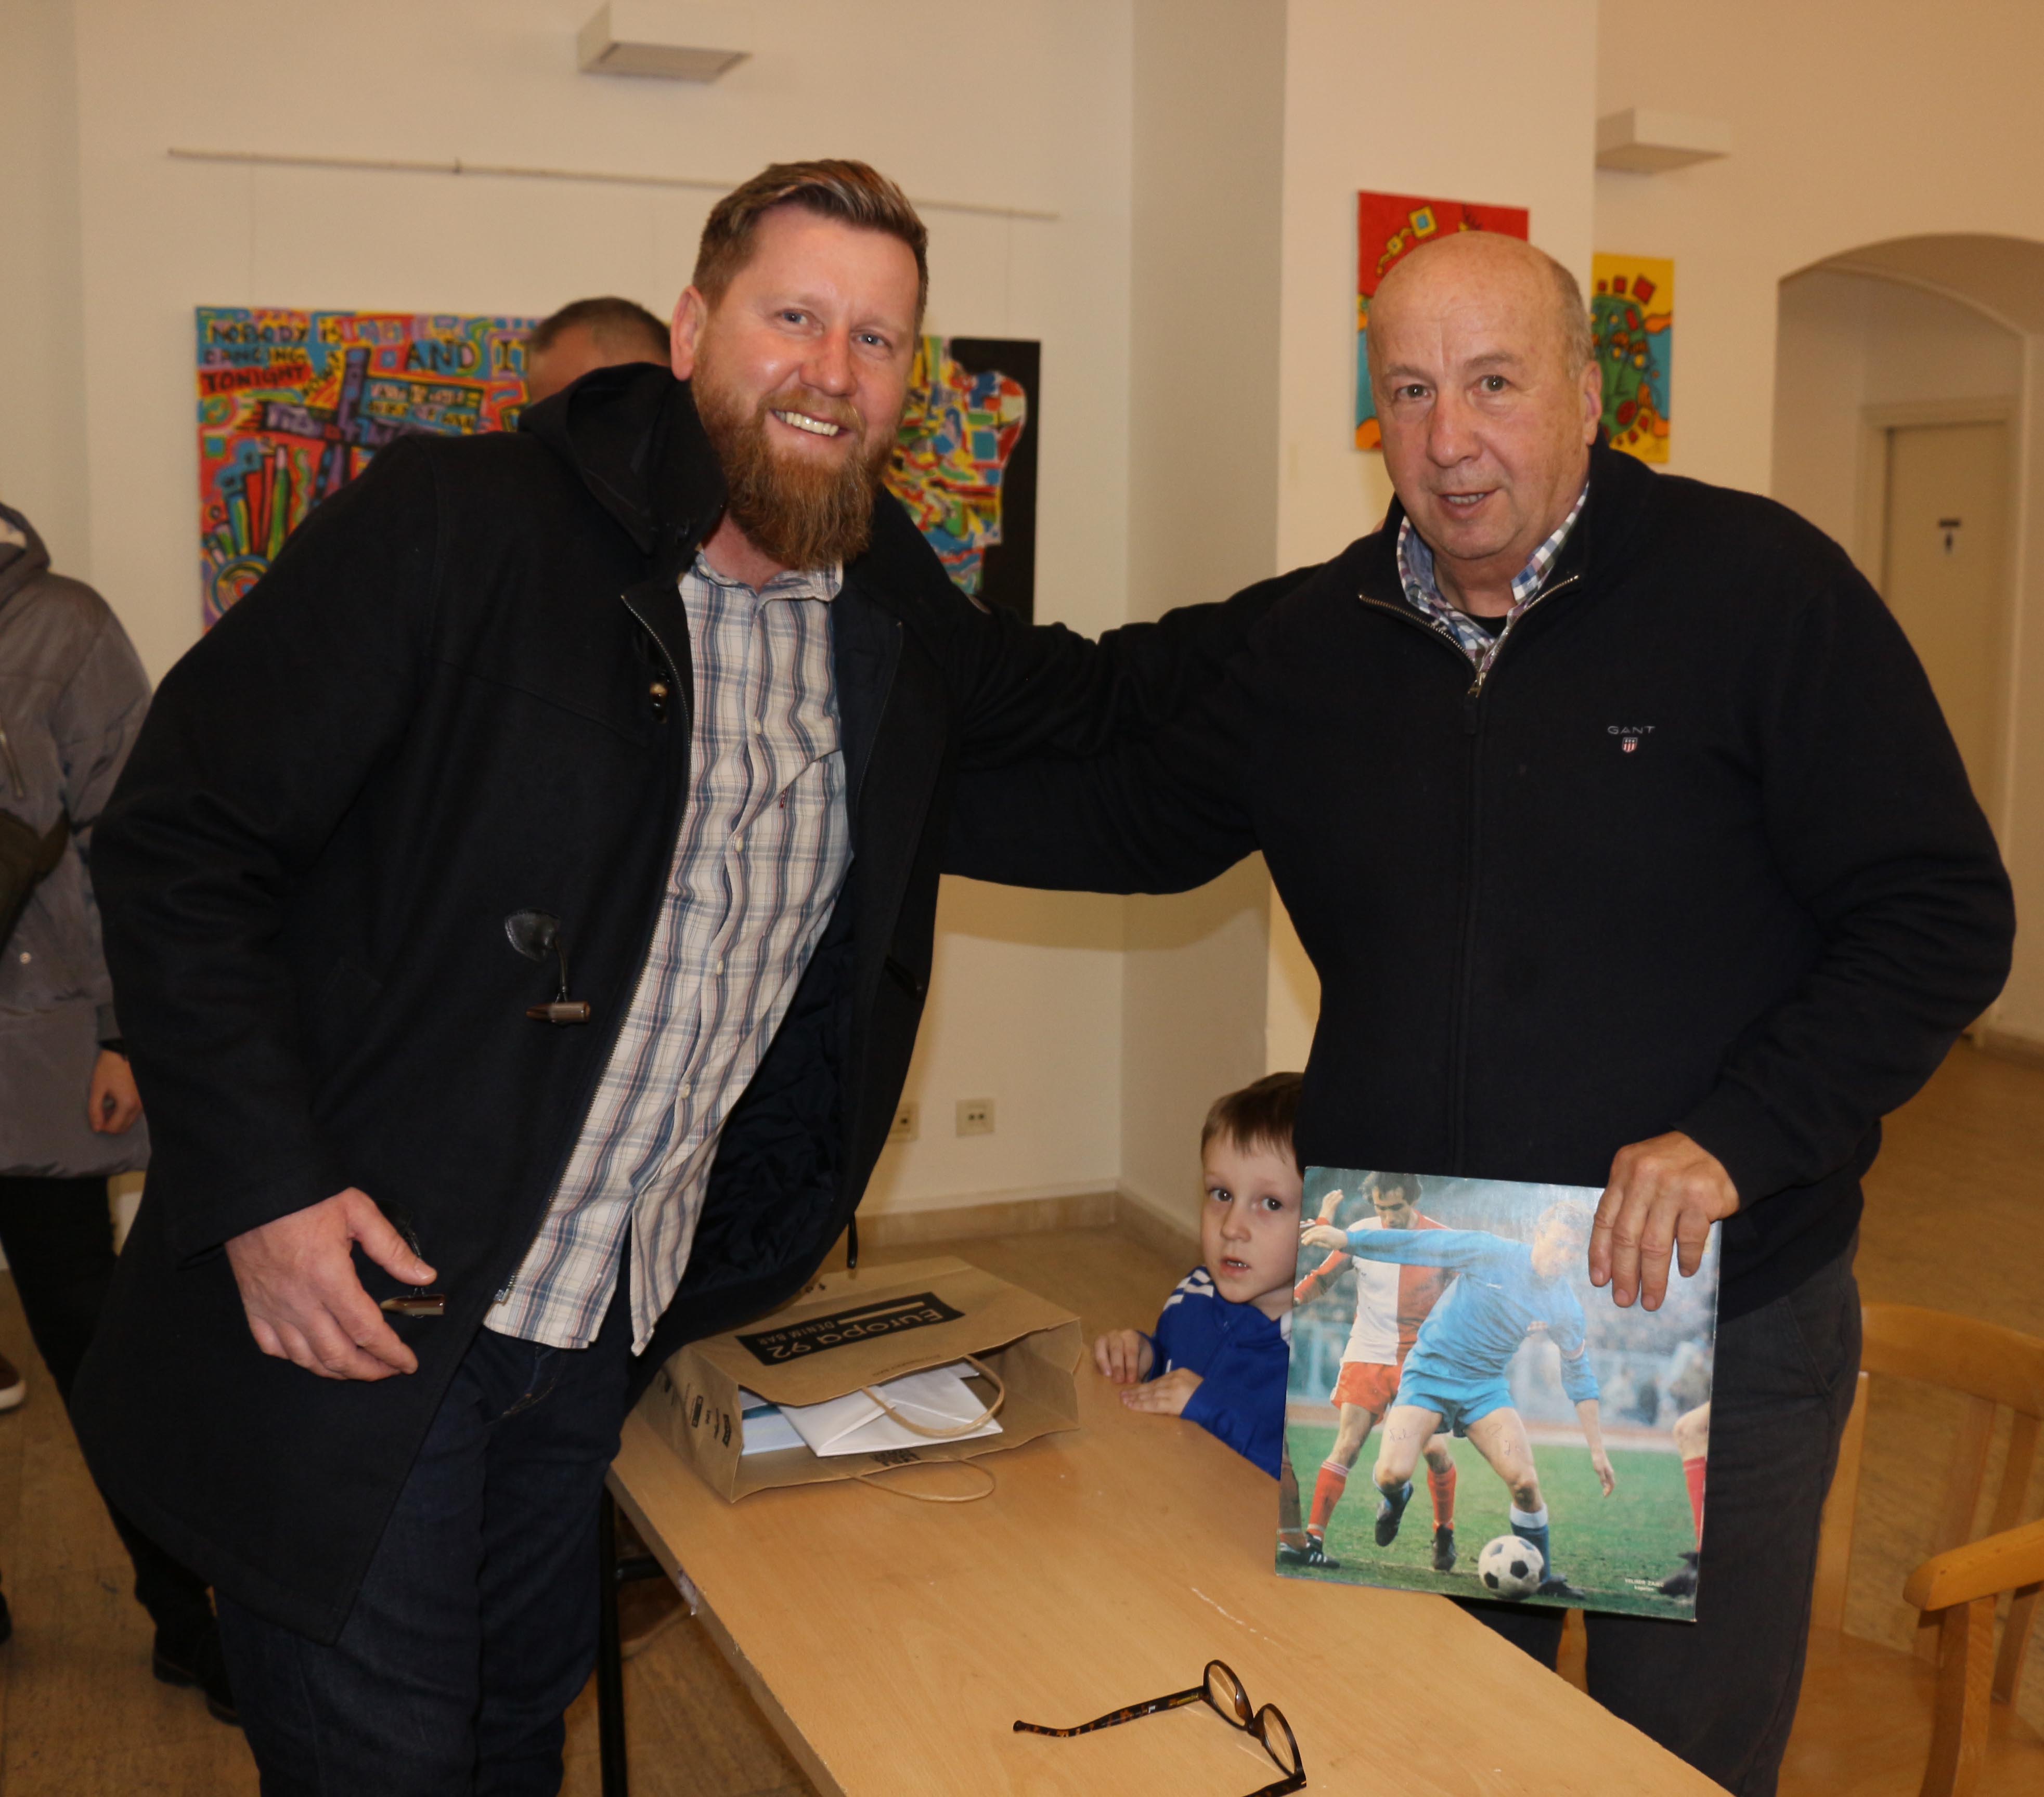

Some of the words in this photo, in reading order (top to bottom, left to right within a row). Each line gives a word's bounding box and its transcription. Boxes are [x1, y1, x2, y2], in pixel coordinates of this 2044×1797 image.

[212, 321, 309, 344] NOBODY
[405, 338, 480, 371] AND
[204, 364, 306, 393] TONIGHT
[1607, 725, 1656, 734] GANT
[788, 1320, 835, 1338] DENIM
[817, 1308, 943, 1344] Europa
[758, 1332, 786, 1346] BAR
[766, 1340, 811, 1359] 92
